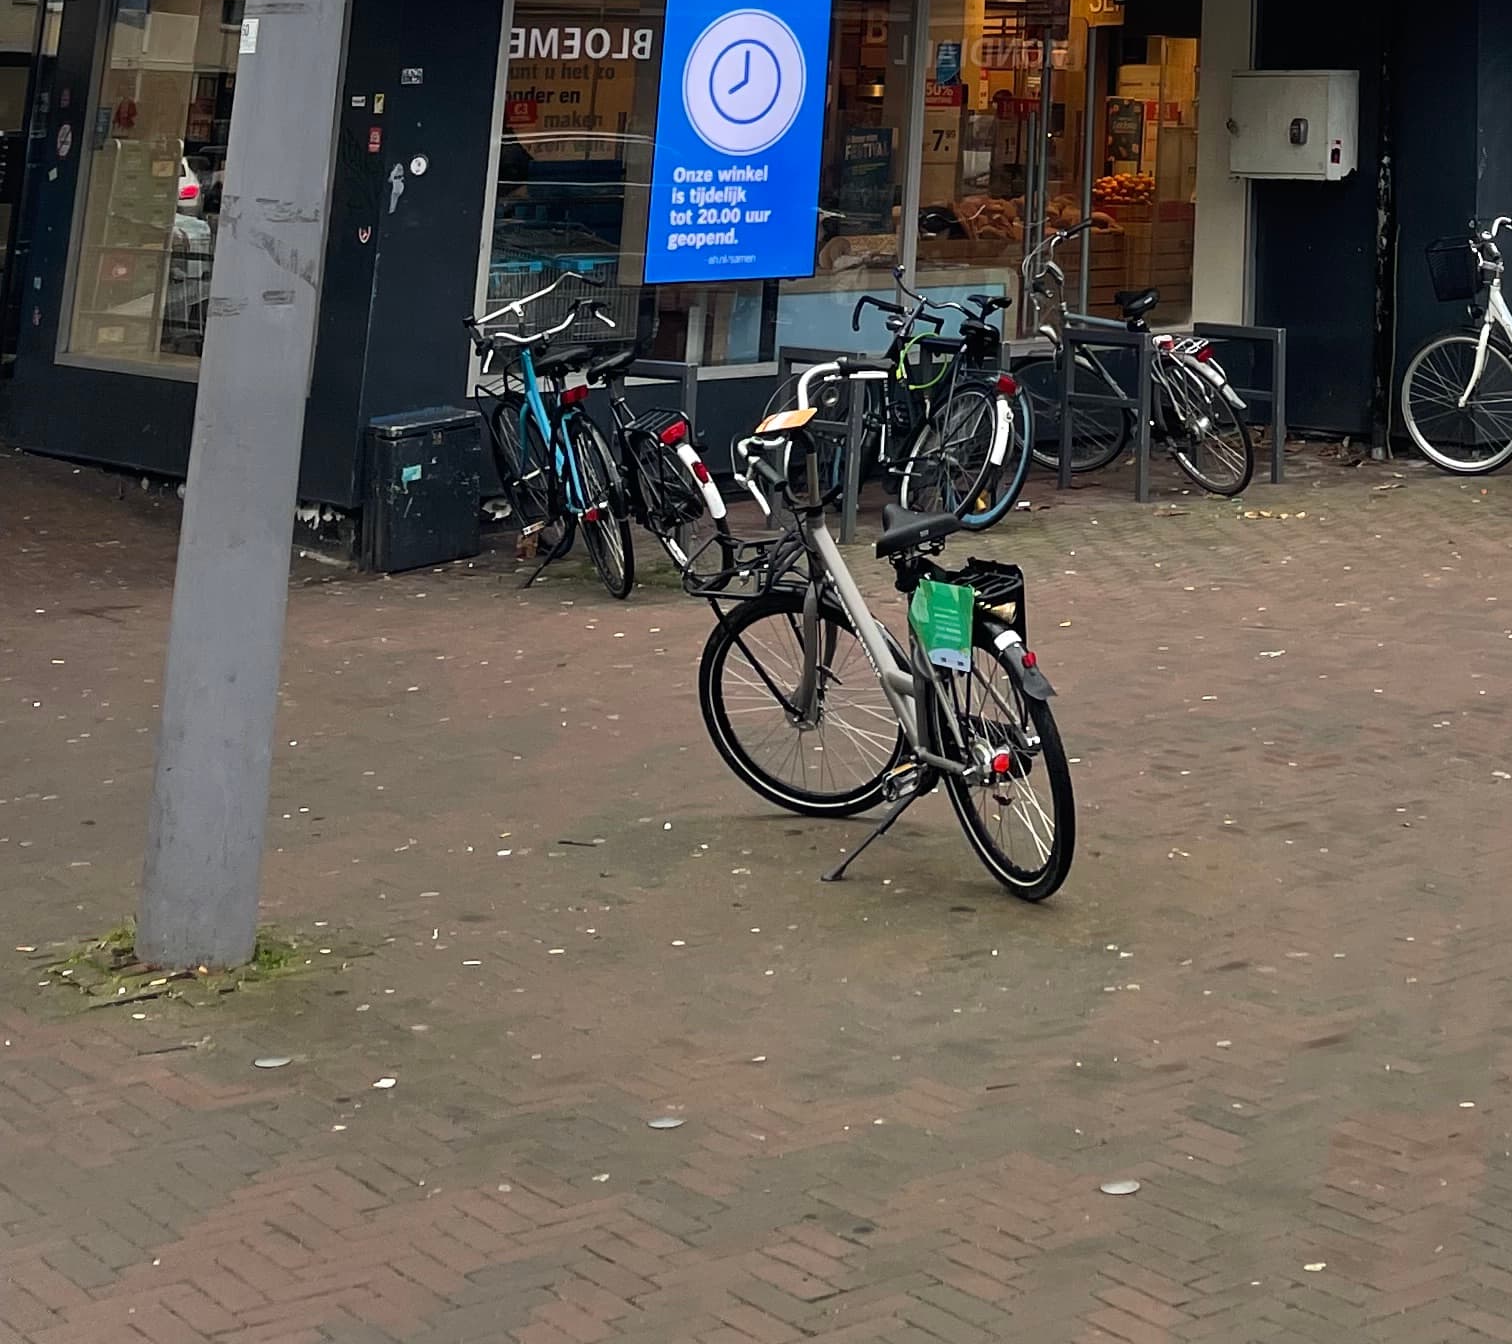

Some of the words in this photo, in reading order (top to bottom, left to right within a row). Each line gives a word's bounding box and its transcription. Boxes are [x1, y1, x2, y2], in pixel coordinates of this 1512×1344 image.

[673, 167, 713, 183] Onze
[718, 164, 769, 183] winkel
[671, 186, 685, 205] is
[689, 185, 747, 207] tijdelijk
[670, 209, 693, 226] tot
[697, 208, 741, 225] 20.00
[745, 210, 772, 223] uur
[667, 228, 739, 251] geopend.
